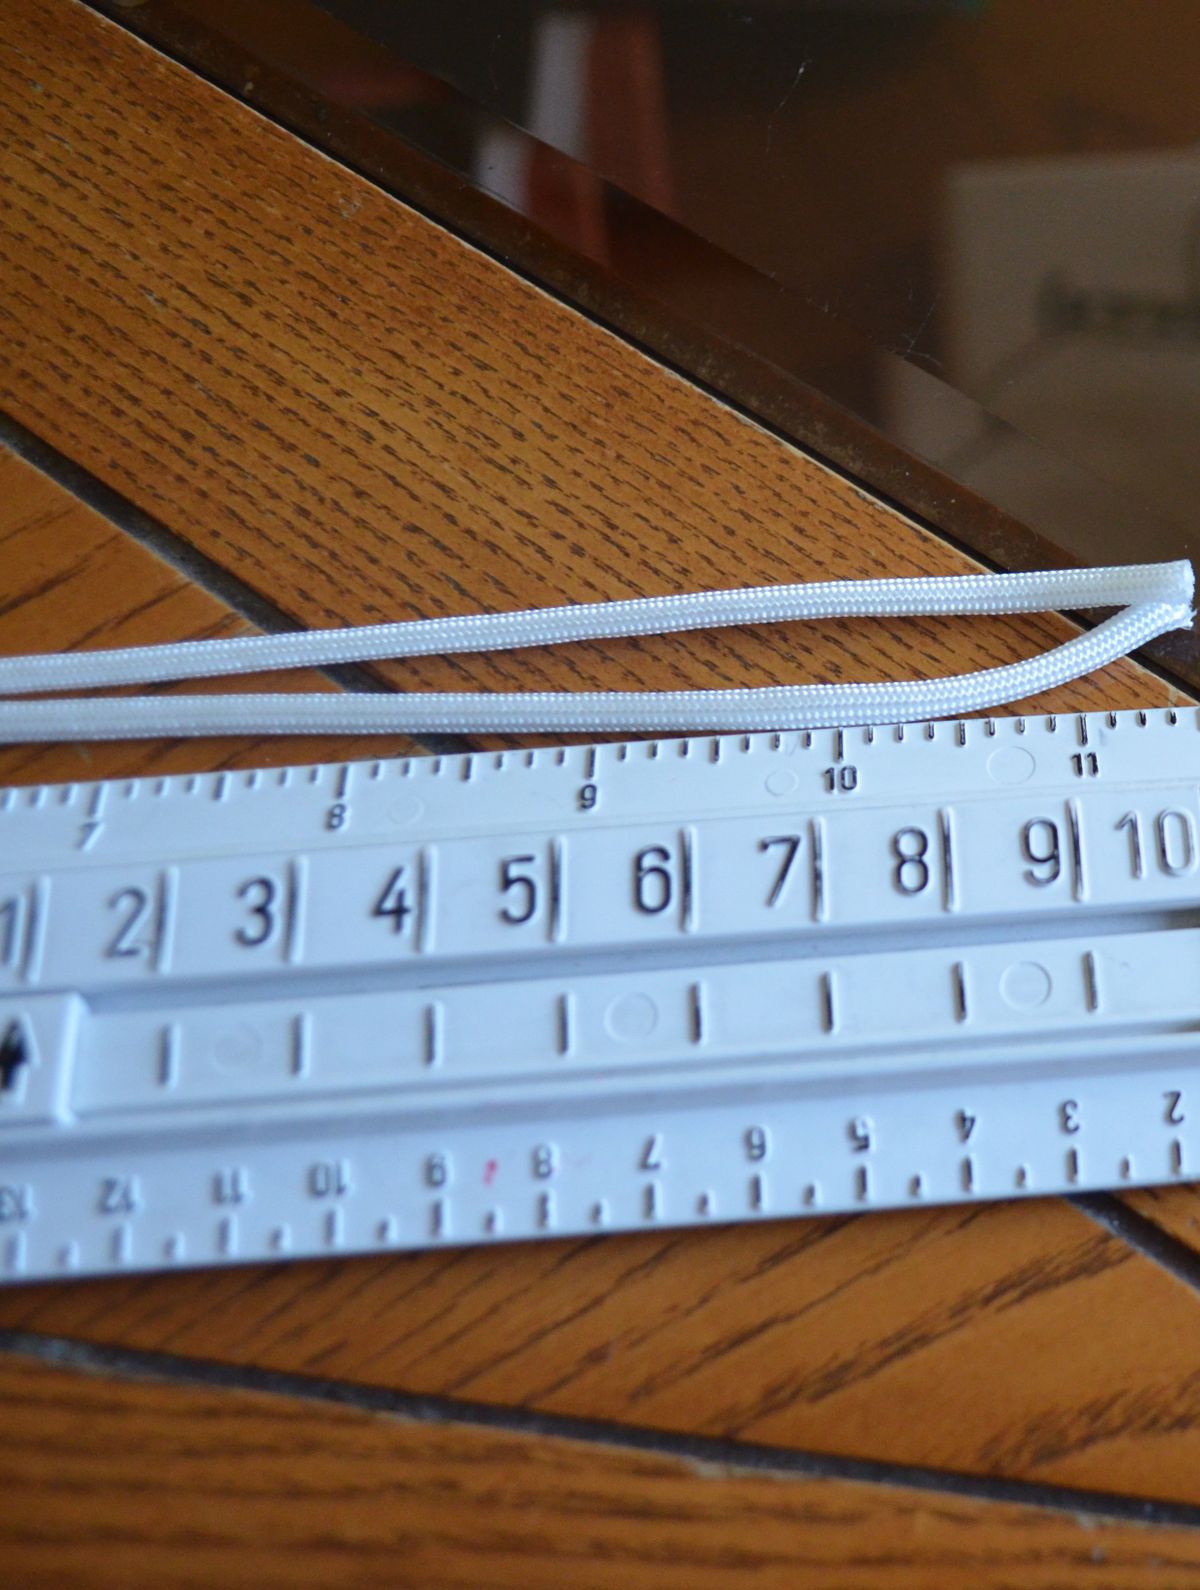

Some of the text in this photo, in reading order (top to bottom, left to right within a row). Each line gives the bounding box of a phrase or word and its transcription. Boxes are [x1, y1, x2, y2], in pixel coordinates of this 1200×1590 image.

[326, 804, 347, 829] 8
[580, 784, 598, 809] 9
[822, 765, 858, 792] 10
[1072, 753, 1101, 778] 11
[105, 887, 149, 958] 2
[234, 876, 278, 948] 3
[371, 867, 411, 933] 4
[500, 855, 537, 924] 5
[632, 846, 673, 914] 6
[758, 834, 802, 907] 7
[891, 827, 931, 895] 8
[1022, 817, 1062, 886] 9
[1114, 808, 1198, 880] 10
[1059, 1100, 1080, 1134] 3
[1164, 1090, 1185, 1125] 2
[745, 1127, 767, 1160] 6
[850, 1117, 873, 1153] 5
[956, 1109, 976, 1144] 4
[426, 1152, 450, 1185] 9
[534, 1143, 558, 1179] 8
[640, 1135, 663, 1170] 7
[312, 1159, 347, 1197] 10
